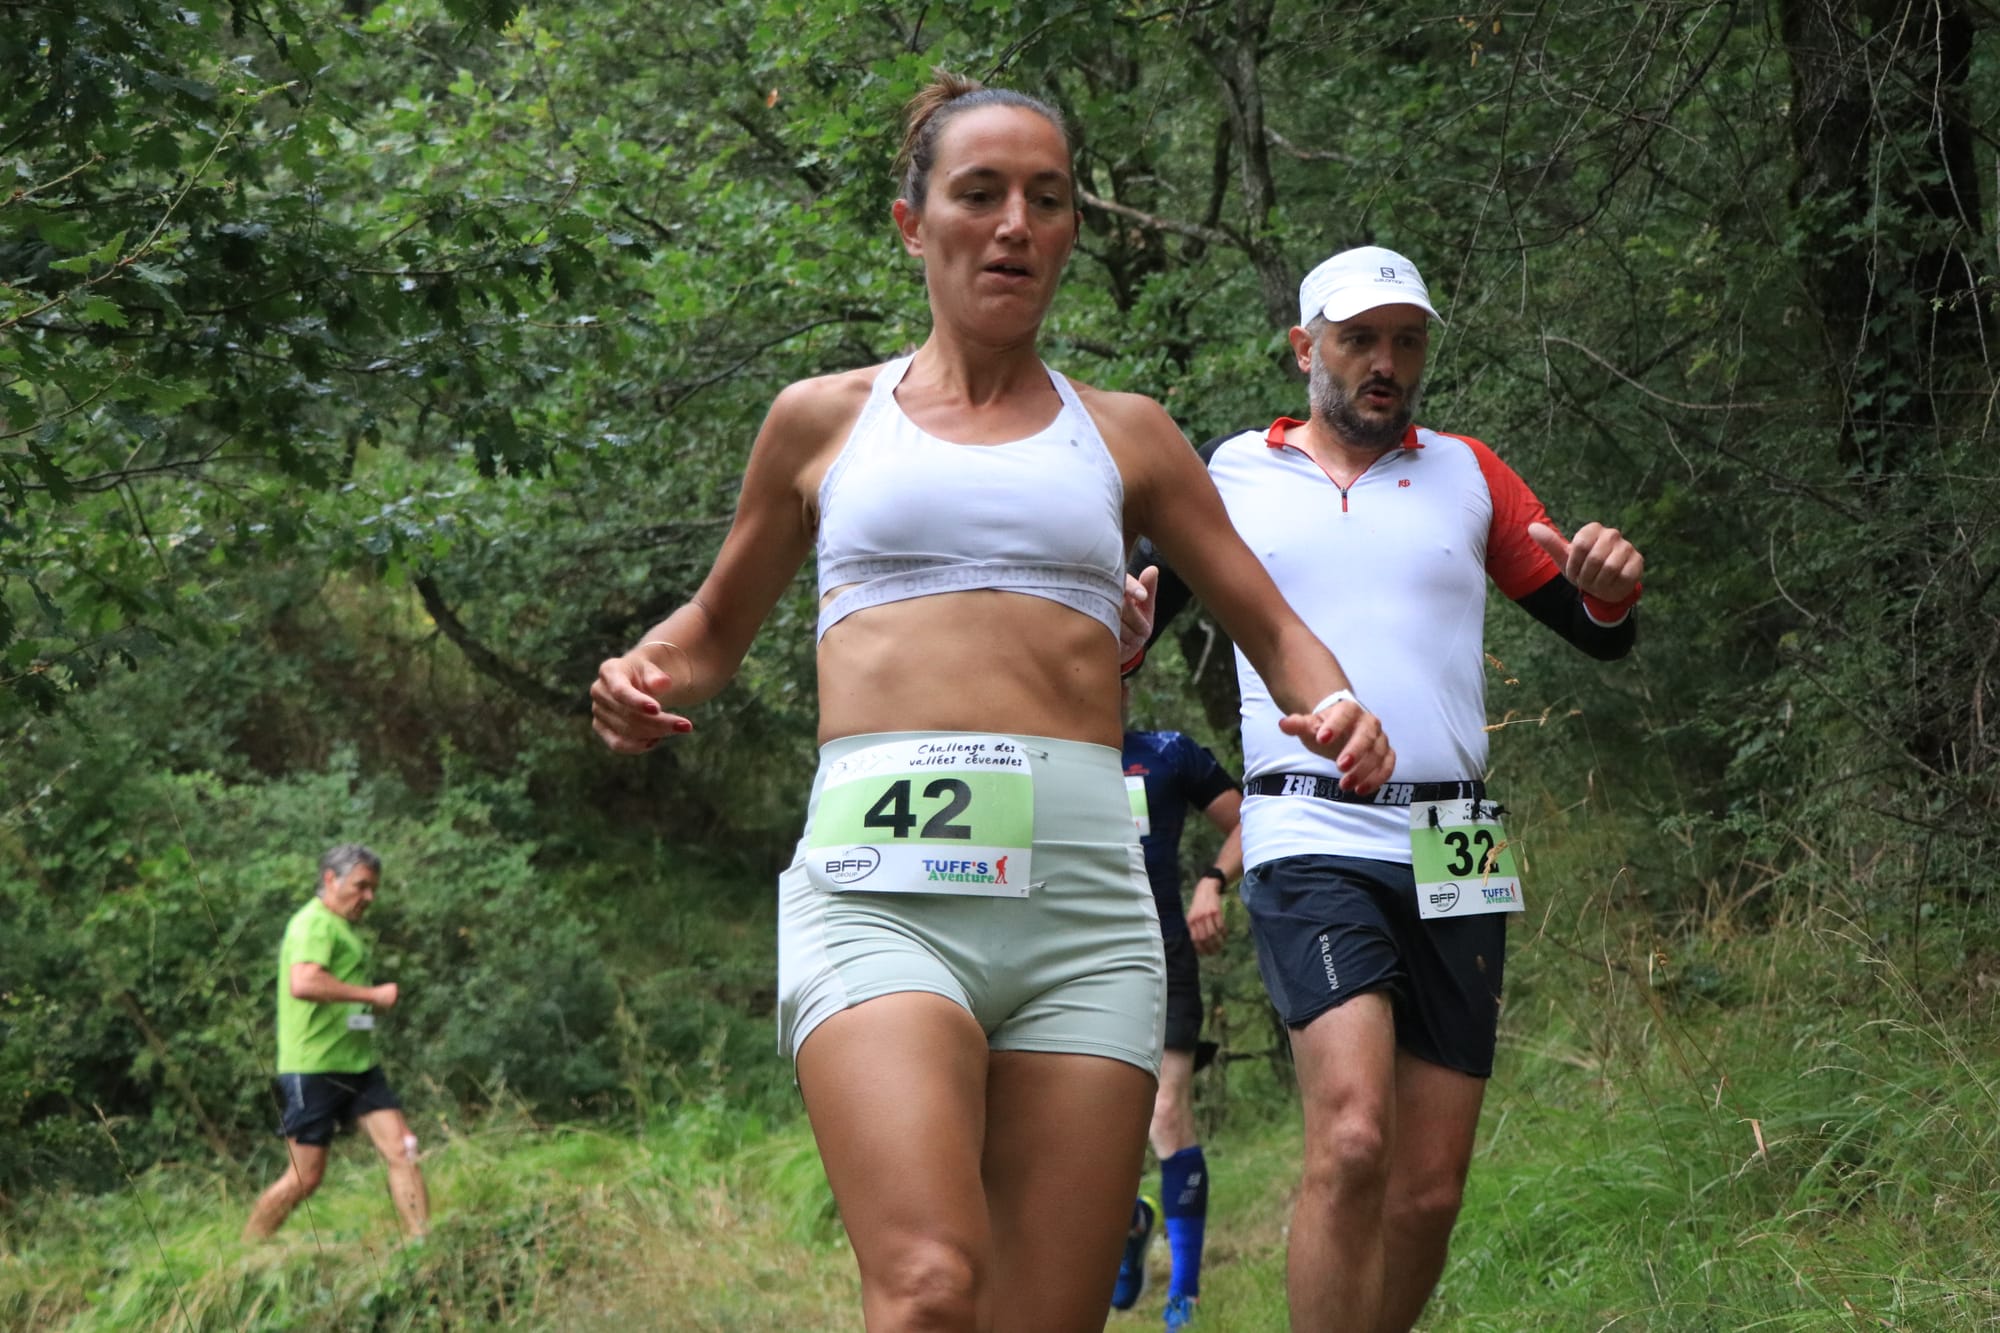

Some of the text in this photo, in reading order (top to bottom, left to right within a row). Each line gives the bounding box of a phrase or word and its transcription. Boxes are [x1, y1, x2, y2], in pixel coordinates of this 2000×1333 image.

[917, 742, 1015, 755] Challenge des
[909, 753, 1022, 767] vallées cévenoles
[864, 778, 972, 839] 42
[1444, 829, 1500, 877] 32
[825, 859, 872, 873] BFP
[922, 859, 988, 874] TUFF'S
[928, 869, 995, 884] Aventure
[1430, 892, 1456, 904] BFP
[1319, 934, 1340, 990] SALOMON
